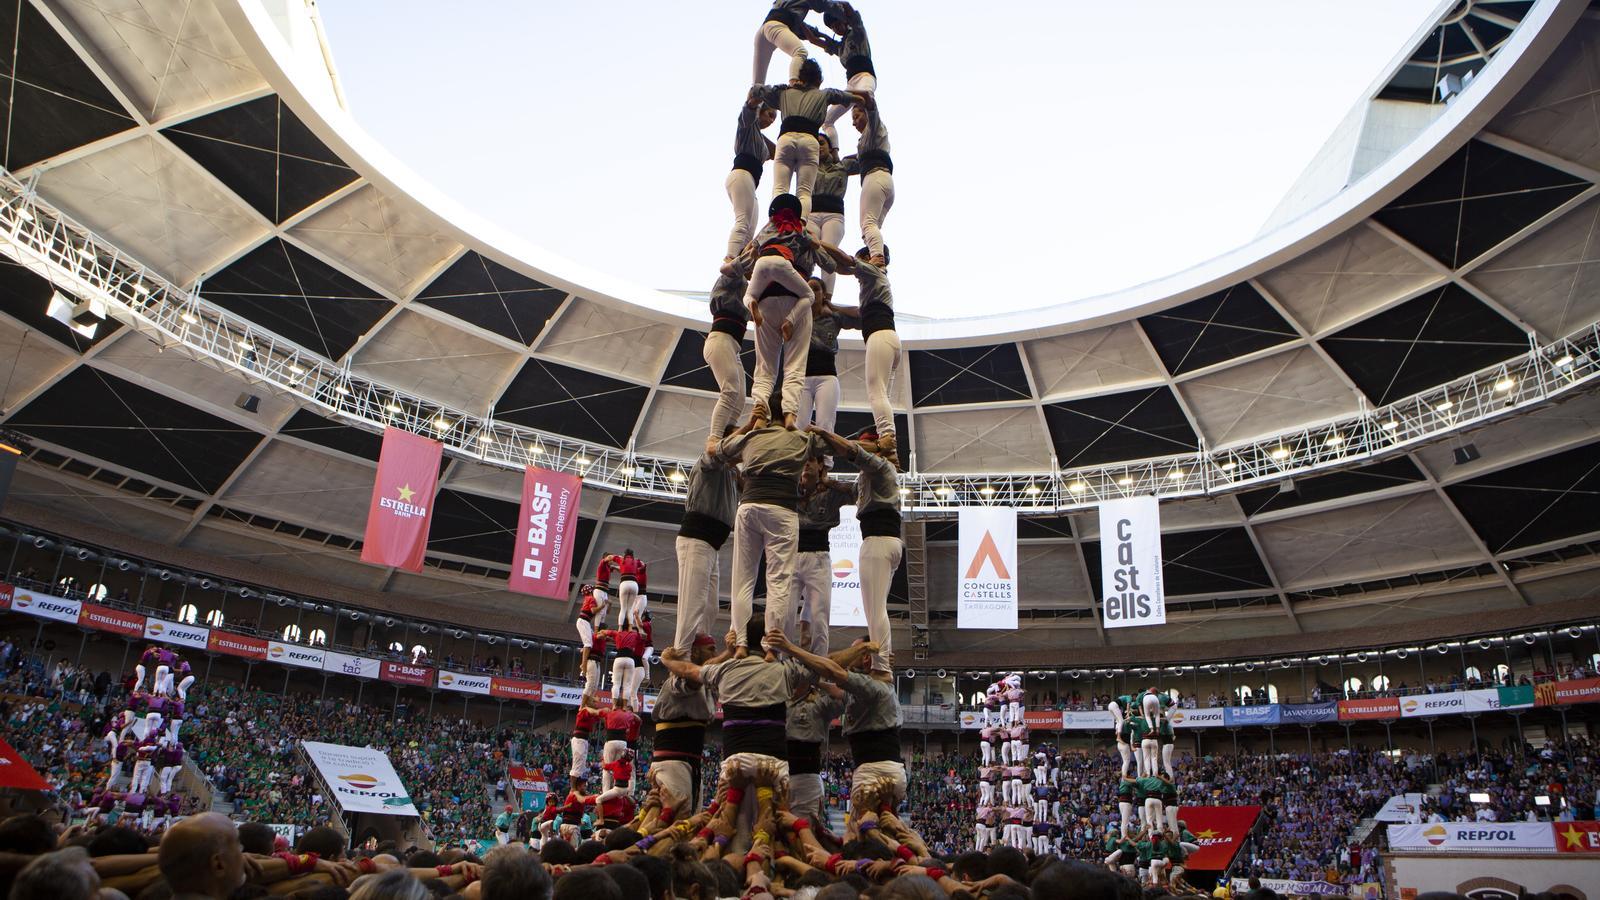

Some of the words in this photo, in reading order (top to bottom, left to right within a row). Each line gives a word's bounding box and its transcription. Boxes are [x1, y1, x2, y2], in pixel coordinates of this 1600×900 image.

[380, 496, 426, 517] ESTRELLA
[555, 487, 570, 532] chemistry
[394, 509, 411, 518] DAMM
[528, 482, 552, 545] BASF
[553, 535, 562, 563] create
[548, 566, 558, 581] We
[38, 601, 78, 616] REPSOL
[90, 613, 121, 627] ESTRELLA
[121, 619, 143, 631] DAMM
[168, 630, 206, 643] REPSOL
[219, 639, 247, 651] ESTRELLA
[247, 645, 267, 654] DAMM
[289, 652, 323, 663] REPSOL
[342, 662, 361, 675] tac
[402, 666, 426, 676] BASF
[458, 679, 490, 689] REPSOL
[499, 685, 524, 695] ESTRELLA
[560, 692, 582, 700] REPS
[1348, 705, 1378, 713] ESTRELLA
[1378, 704, 1399, 712] DAMM
[1424, 699, 1463, 709] REPSOL
[1246, 706, 1270, 715] BASF
[1295, 708, 1336, 717] VANGUARDIA
[1189, 713, 1222, 721] REPSOL
[338, 787, 400, 797] REPSOL
[1457, 830, 1516, 841] REPSOL
